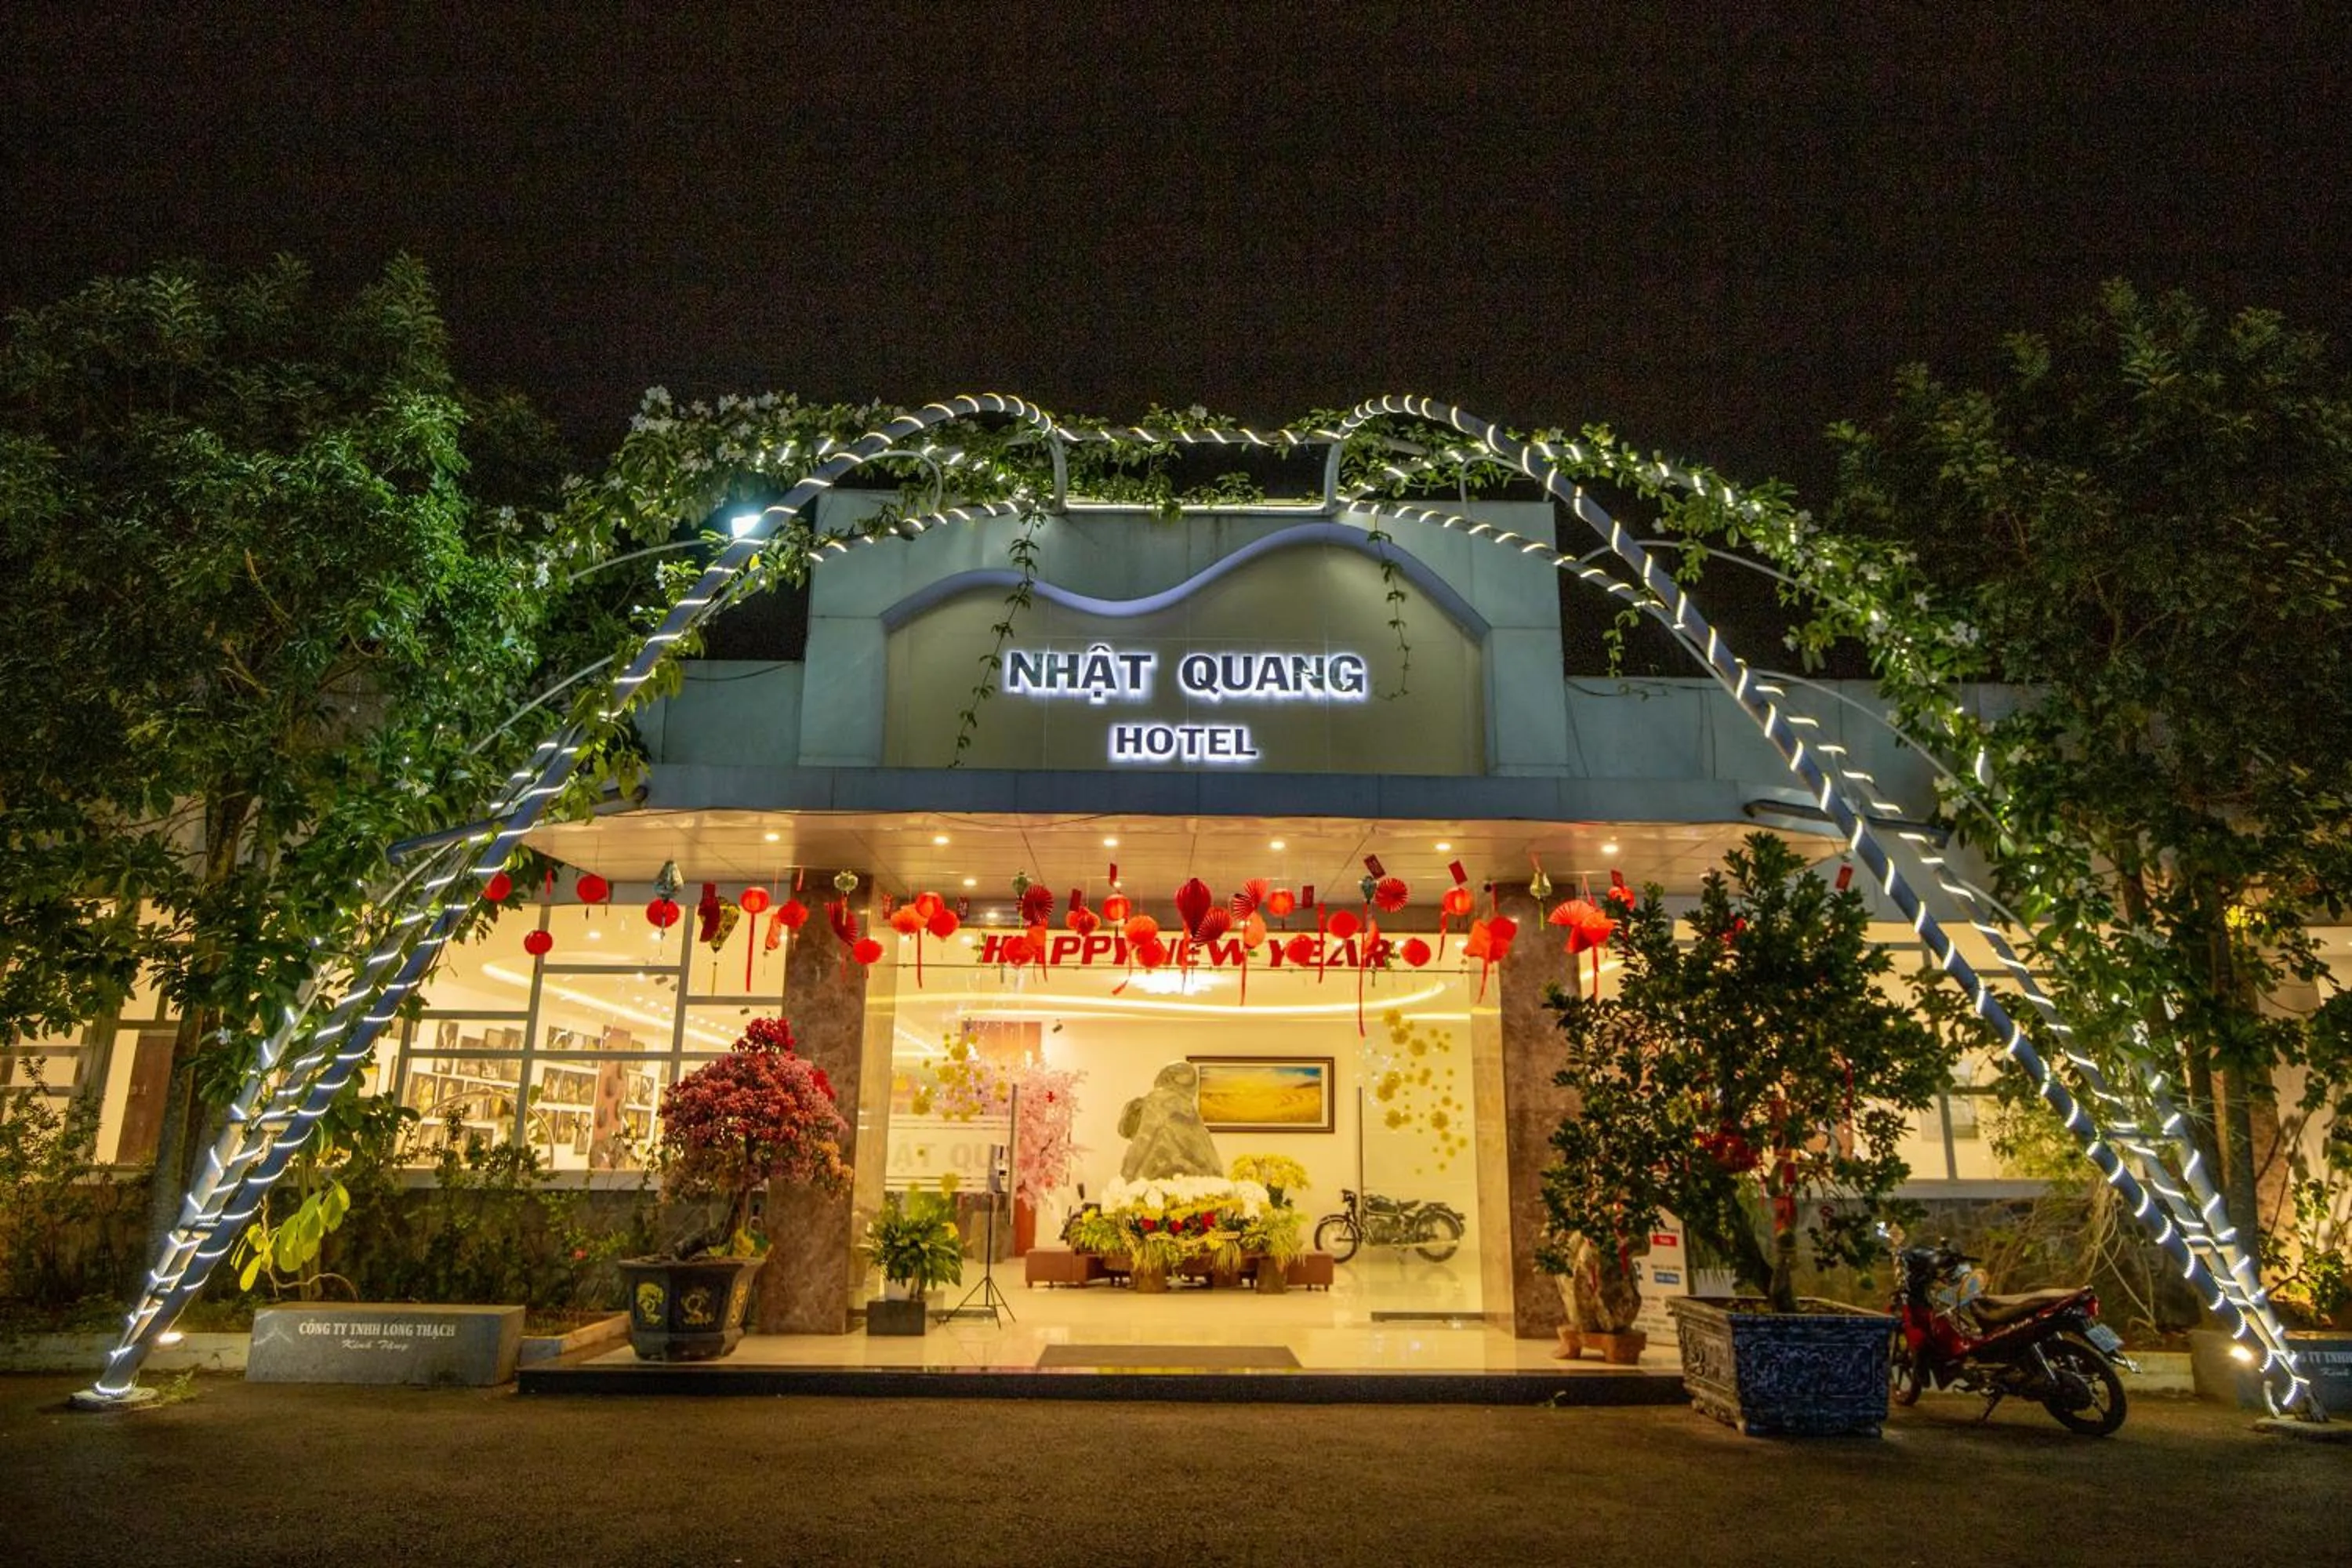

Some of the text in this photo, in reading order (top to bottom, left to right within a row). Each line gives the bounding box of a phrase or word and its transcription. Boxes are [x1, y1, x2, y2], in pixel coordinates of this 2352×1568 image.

[1007, 644, 1365, 699] NHẬT QUANG
[1115, 725, 1258, 757] HOTEL
[982, 935, 1137, 965] HPPY
[299, 1318, 331, 1335] CÔNG
[333, 1323, 347, 1335] TY
[350, 1323, 381, 1336] TNHH
[383, 1323, 414, 1337] LONG
